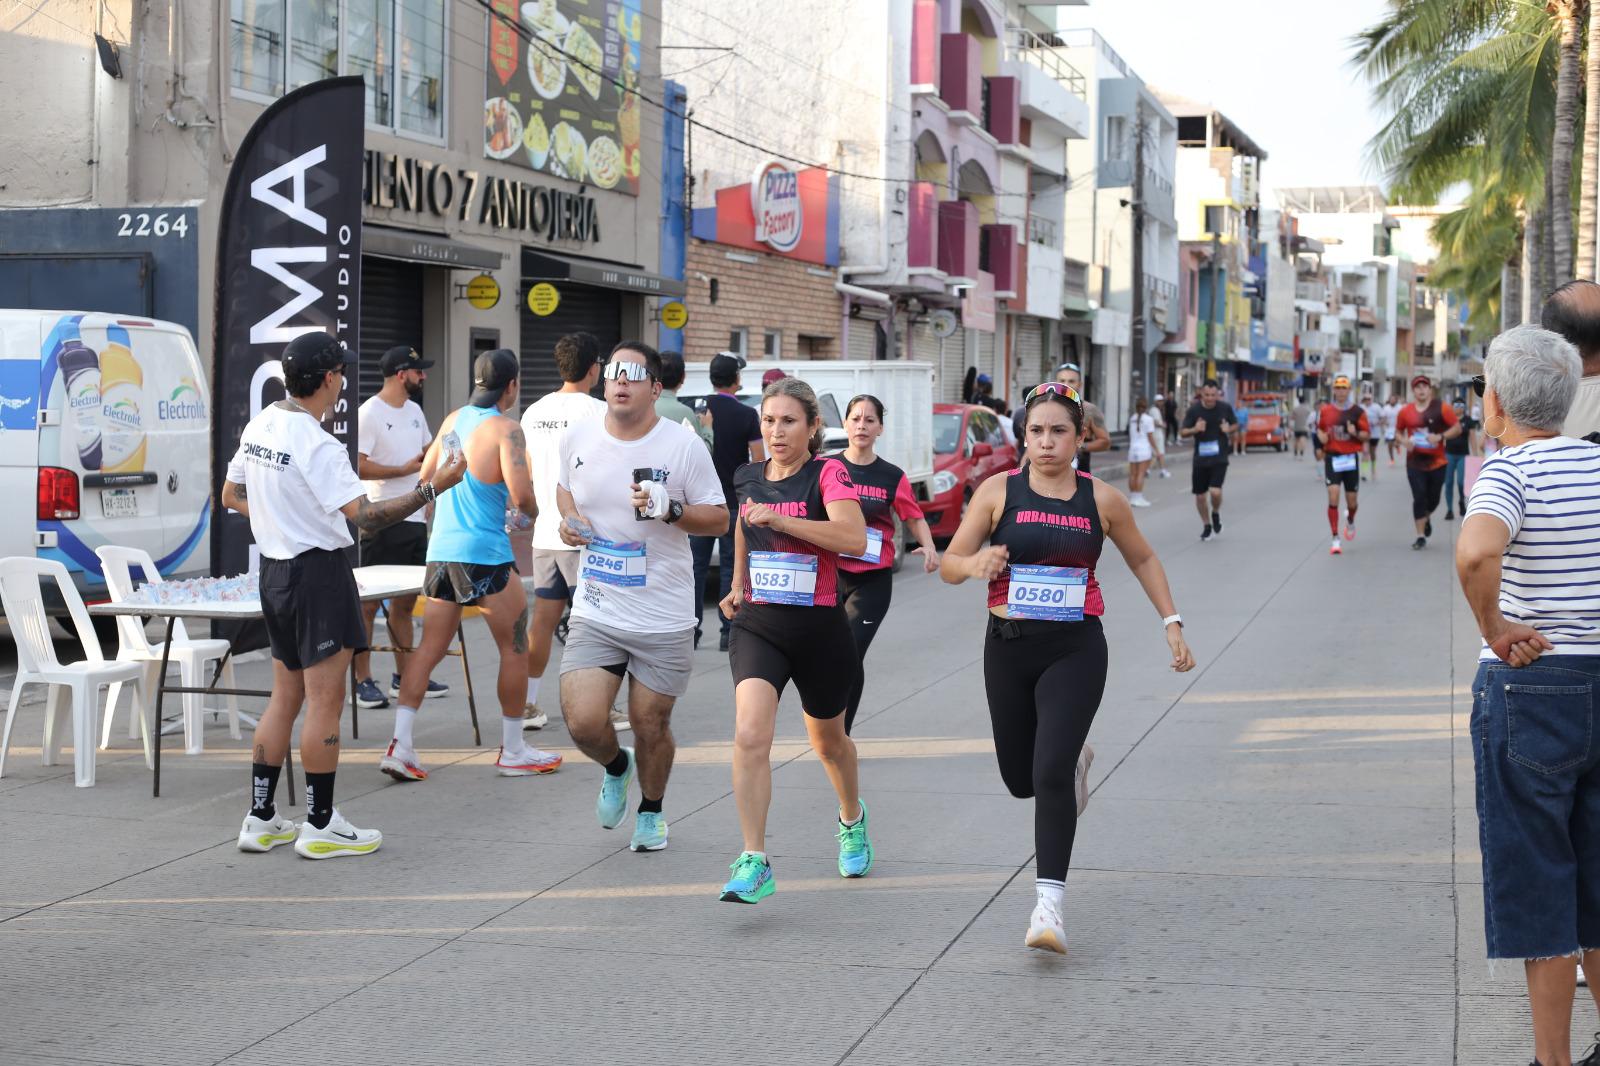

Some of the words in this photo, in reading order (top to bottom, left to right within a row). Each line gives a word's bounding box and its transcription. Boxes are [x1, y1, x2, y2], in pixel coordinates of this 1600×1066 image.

[364, 149, 453, 217] IENTO
[458, 169, 479, 222] 7
[479, 175, 600, 243] ANTOJERÍA
[765, 171, 797, 202] Pizza
[117, 213, 189, 239] 2264
[763, 210, 796, 236] Factory
[71, 394, 99, 408] Electrol
[159, 400, 207, 421] Electrolit
[103, 405, 142, 426] Electrolit
[1016, 510, 1092, 530] URBANIANOS
[587, 554, 624, 571] 0246
[754, 572, 790, 588] 0583
[1014, 586, 1065, 604] 0580
[253, 776, 270, 810] MEX
